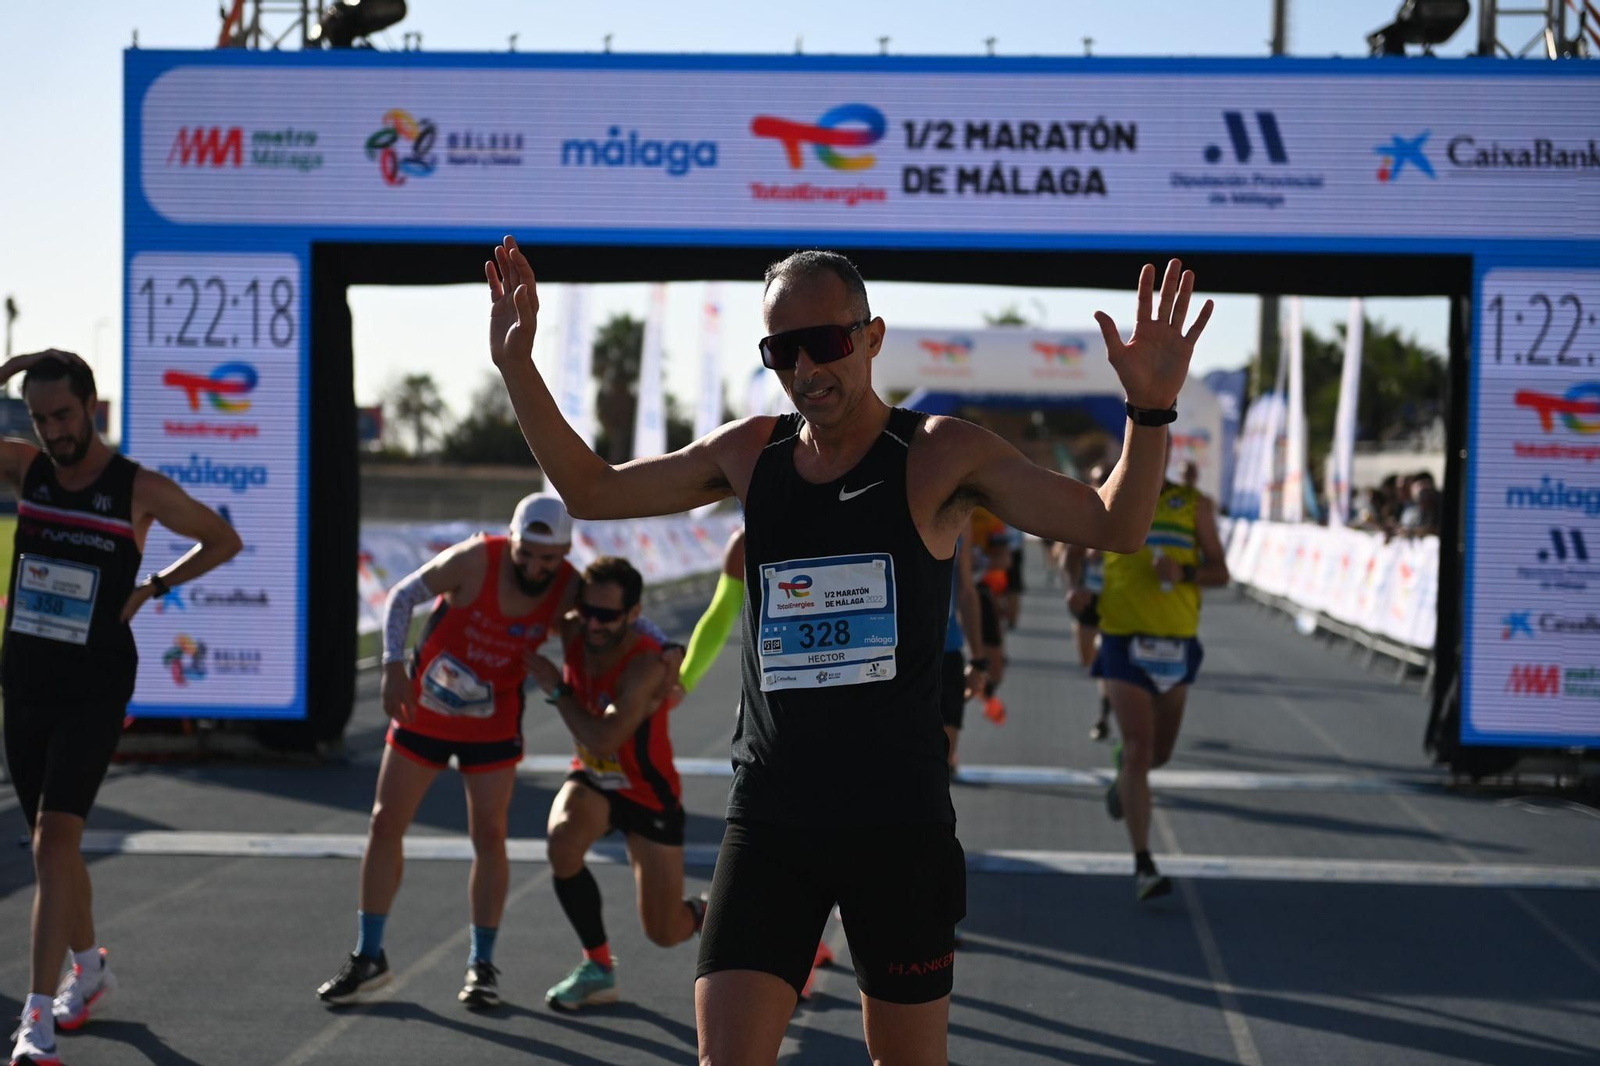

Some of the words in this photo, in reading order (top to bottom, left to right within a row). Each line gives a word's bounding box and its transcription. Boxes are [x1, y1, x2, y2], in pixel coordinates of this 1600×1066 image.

[903, 120, 955, 150] 1/2
[965, 116, 1137, 151] MARATÓN
[561, 126, 718, 176] málaga
[1448, 134, 1600, 168] CaixaBank
[903, 166, 947, 194] DE
[957, 160, 1107, 195] MÁLAGA
[139, 276, 294, 348] 1:22:18
[776, 601, 815, 611] TotalEnergies
[824, 590, 835, 599] 1/2
[836, 587, 869, 598] MARATÓN
[825, 600, 835, 608] DE
[836, 597, 864, 607] MÁLAGA
[866, 595, 883, 603] 2022
[798, 619, 851, 649] 328
[864, 634, 893, 645] málaga
[808, 652, 846, 664] HECTOR
